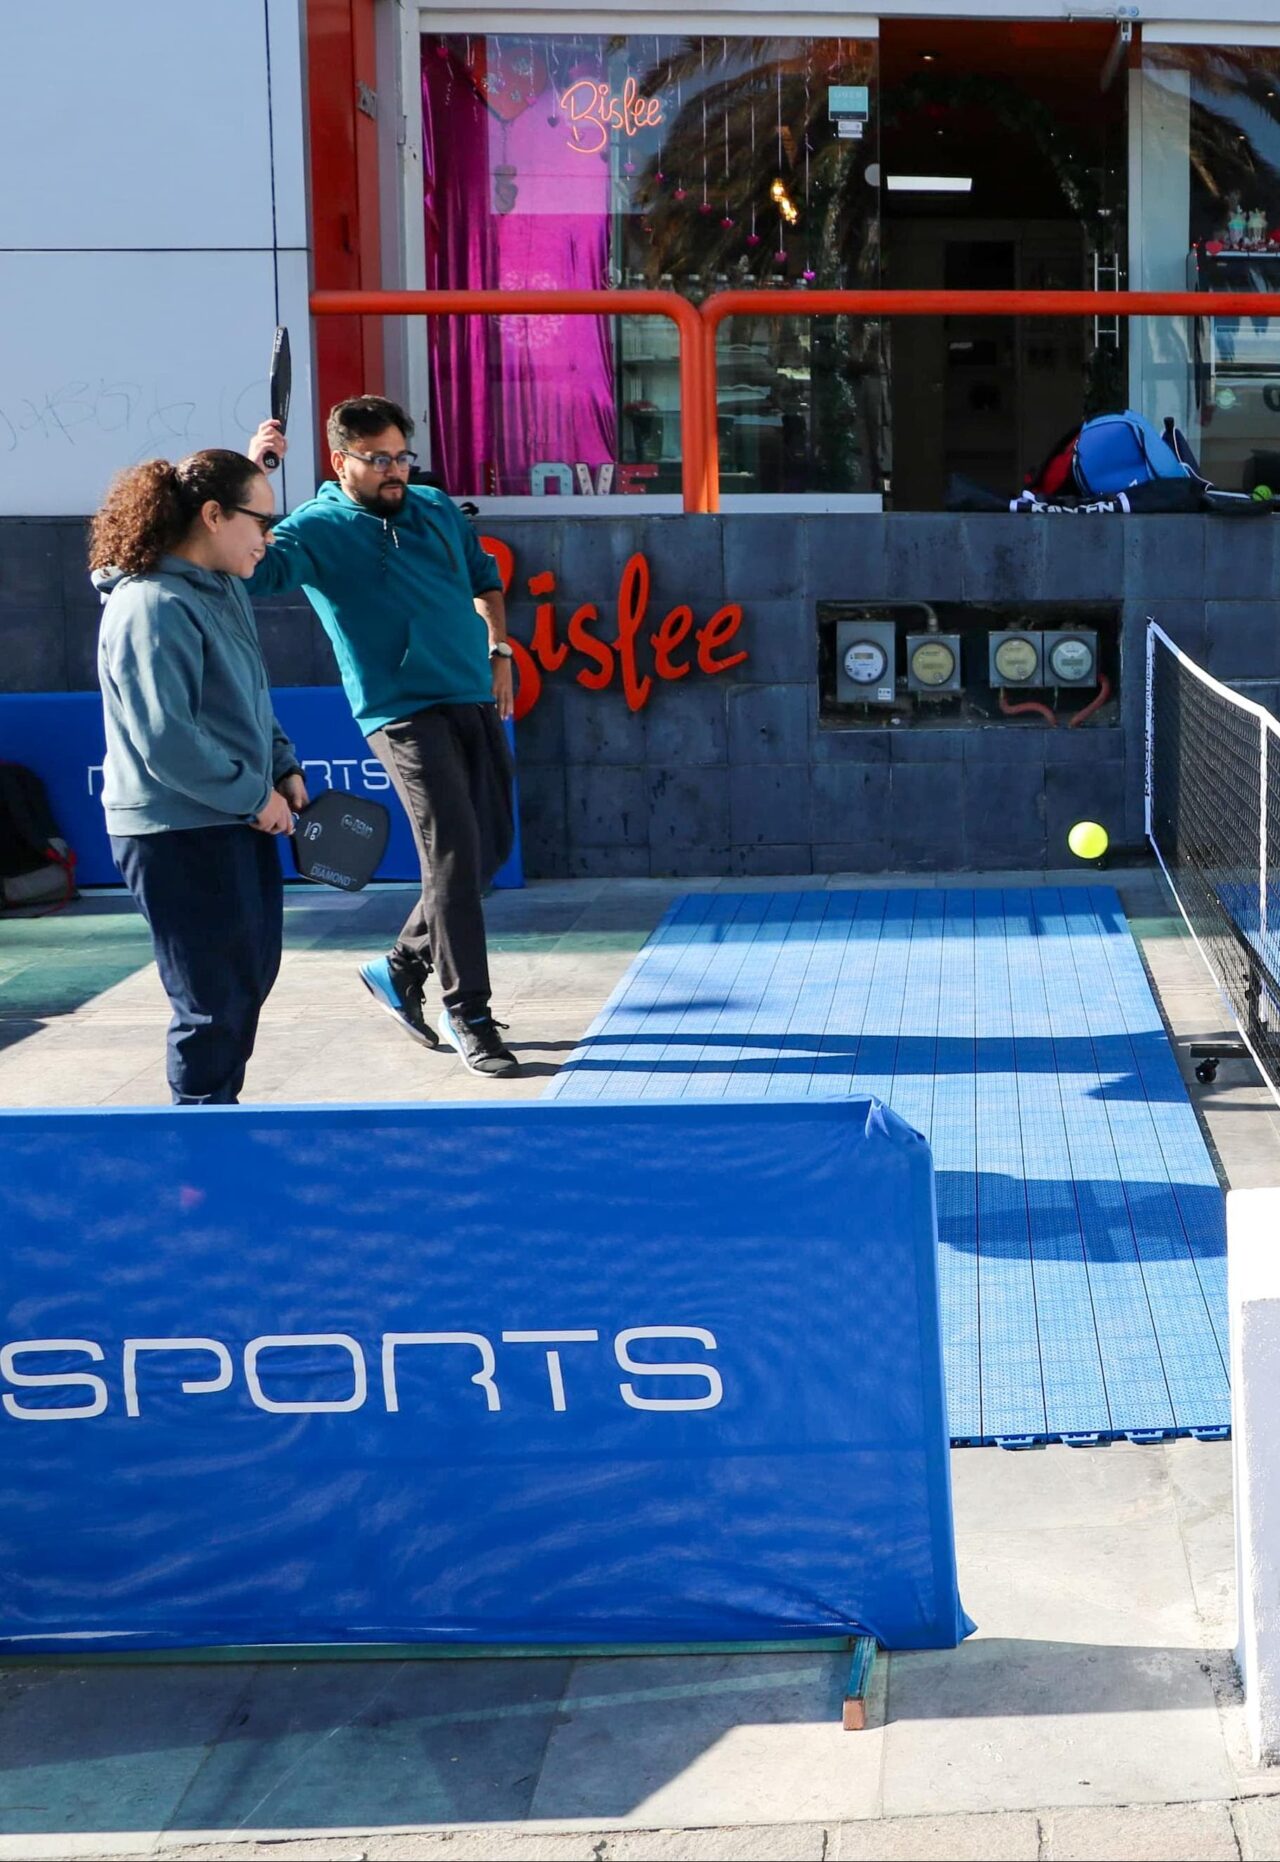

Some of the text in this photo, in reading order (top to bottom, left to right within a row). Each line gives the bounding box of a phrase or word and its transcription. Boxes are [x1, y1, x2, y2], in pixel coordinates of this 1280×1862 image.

[561, 77, 661, 153] Bislee
[310, 865, 352, 887] DIAMOND
[0, 1326, 723, 1421] SPORTS
